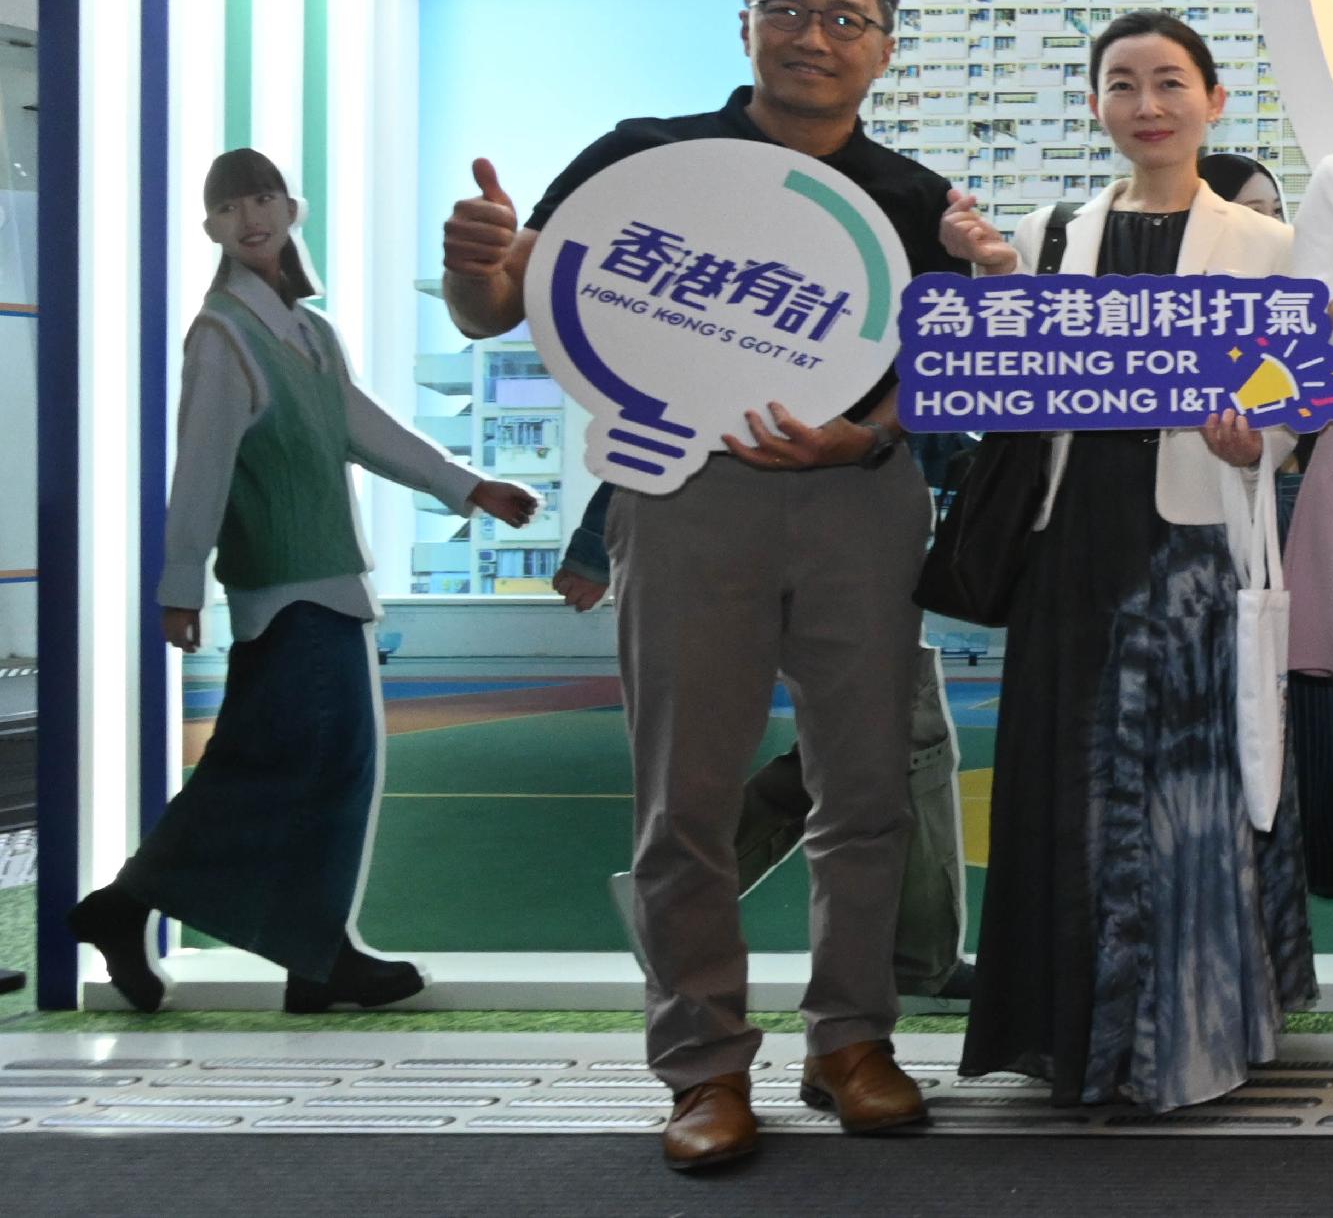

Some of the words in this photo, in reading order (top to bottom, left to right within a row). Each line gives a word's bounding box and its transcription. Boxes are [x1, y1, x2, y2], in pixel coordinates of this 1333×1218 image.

[600, 220, 852, 342] 香港有計
[580, 283, 650, 314] HONG
[651, 307, 737, 342] KONG'S
[738, 336, 788, 359] GOT
[789, 351, 823, 370] I&T
[916, 288, 1317, 339] 為香港創科打氣
[914, 350, 1115, 377] CHEERING
[1126, 349, 1199, 375] FOR
[914, 388, 1036, 416] HONG
[1046, 387, 1161, 415] KONG
[1169, 387, 1225, 413] I&T
